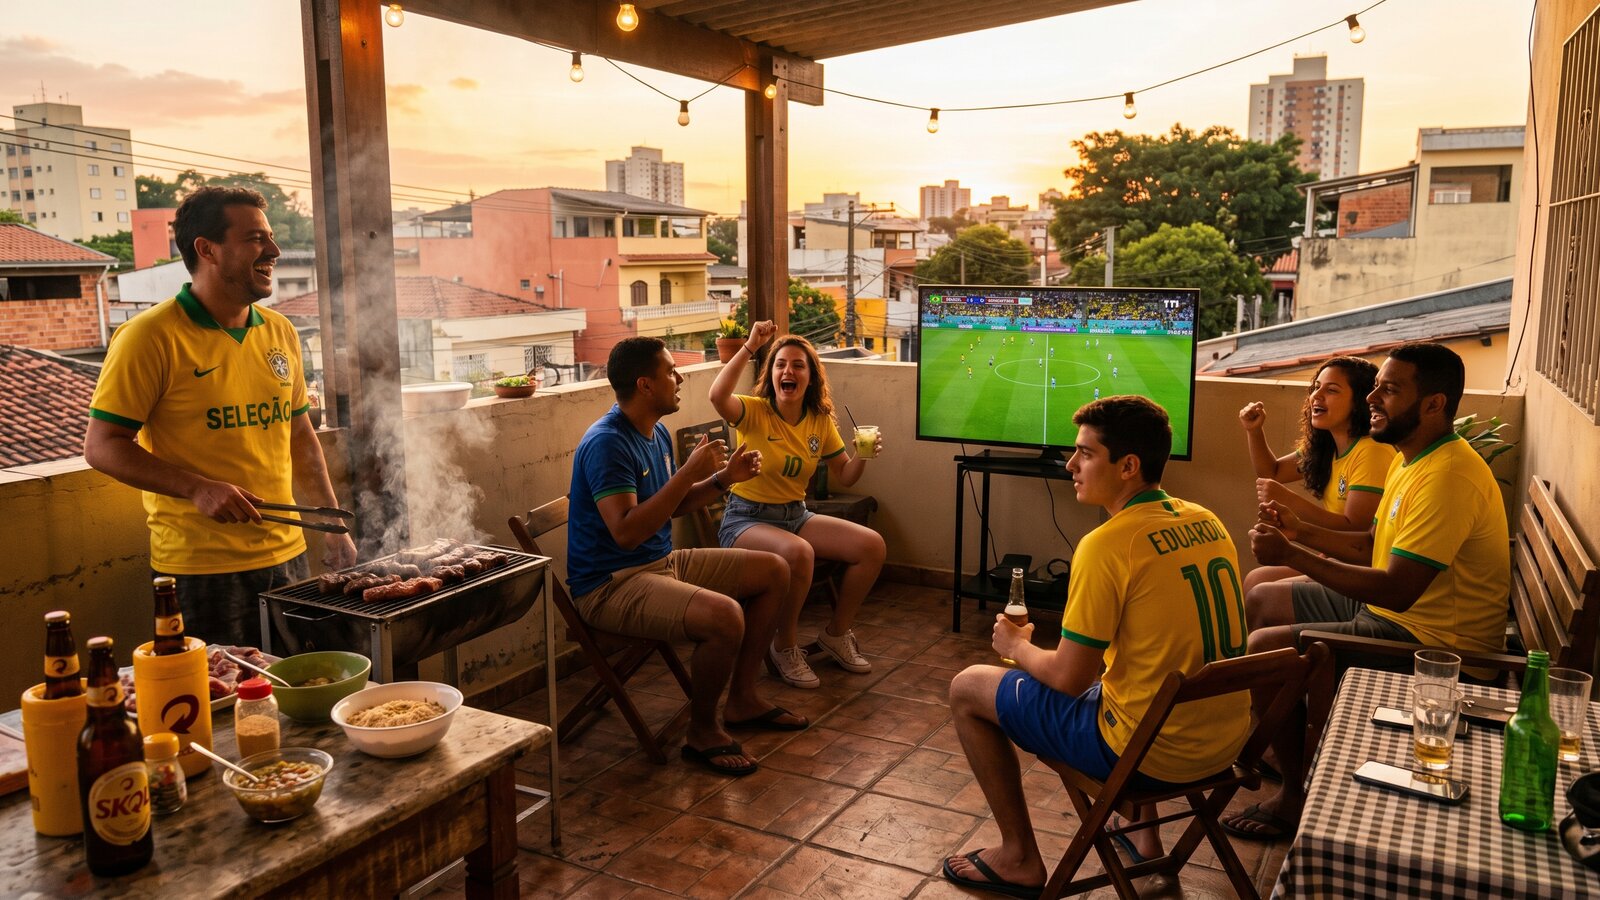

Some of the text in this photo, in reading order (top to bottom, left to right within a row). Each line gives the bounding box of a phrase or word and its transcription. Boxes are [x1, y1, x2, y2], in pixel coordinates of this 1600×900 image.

[206, 397, 291, 430] SELEÇÃO
[782, 455, 803, 478] 10
[1147, 519, 1227, 556] EDUARDO
[1180, 556, 1249, 665] 10
[95, 786, 150, 820] SKOL
